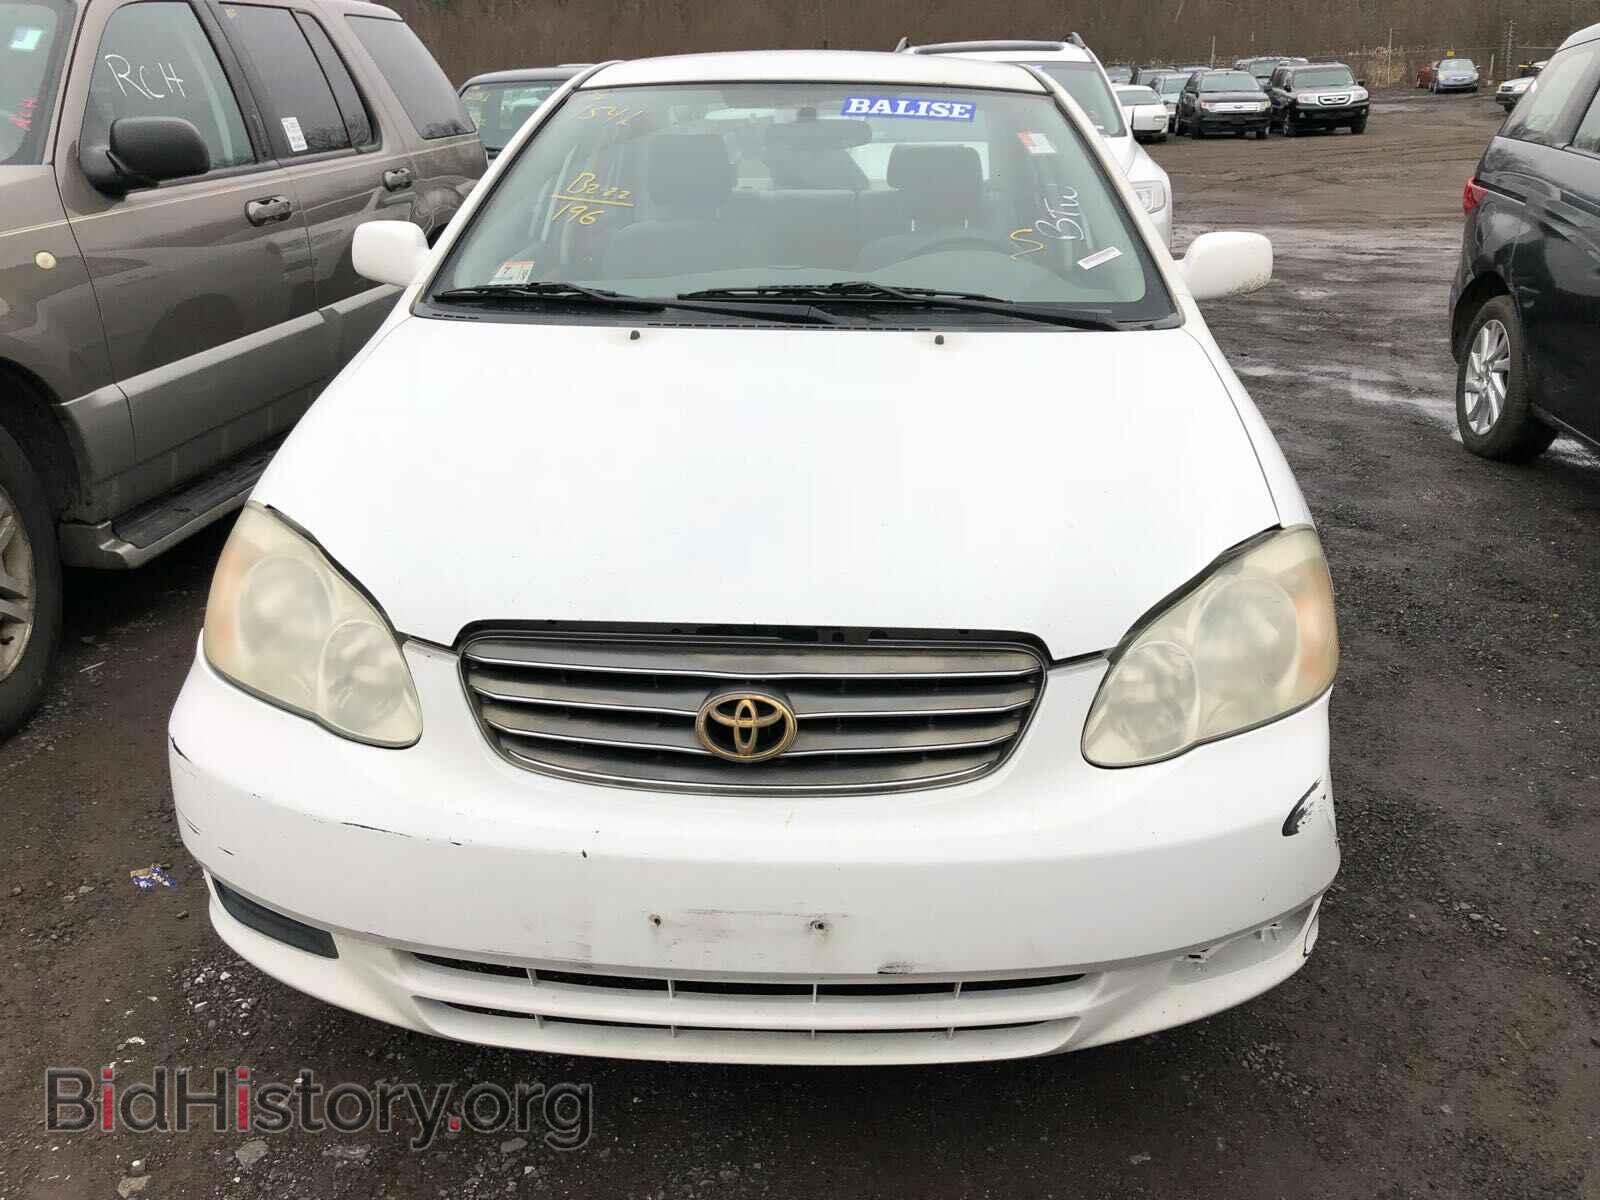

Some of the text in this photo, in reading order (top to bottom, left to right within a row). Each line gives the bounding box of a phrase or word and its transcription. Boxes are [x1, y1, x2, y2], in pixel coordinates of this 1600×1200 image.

[104, 54, 186, 100] RCH
[845, 98, 973, 119] BALISE
[552, 202, 605, 225] 196
